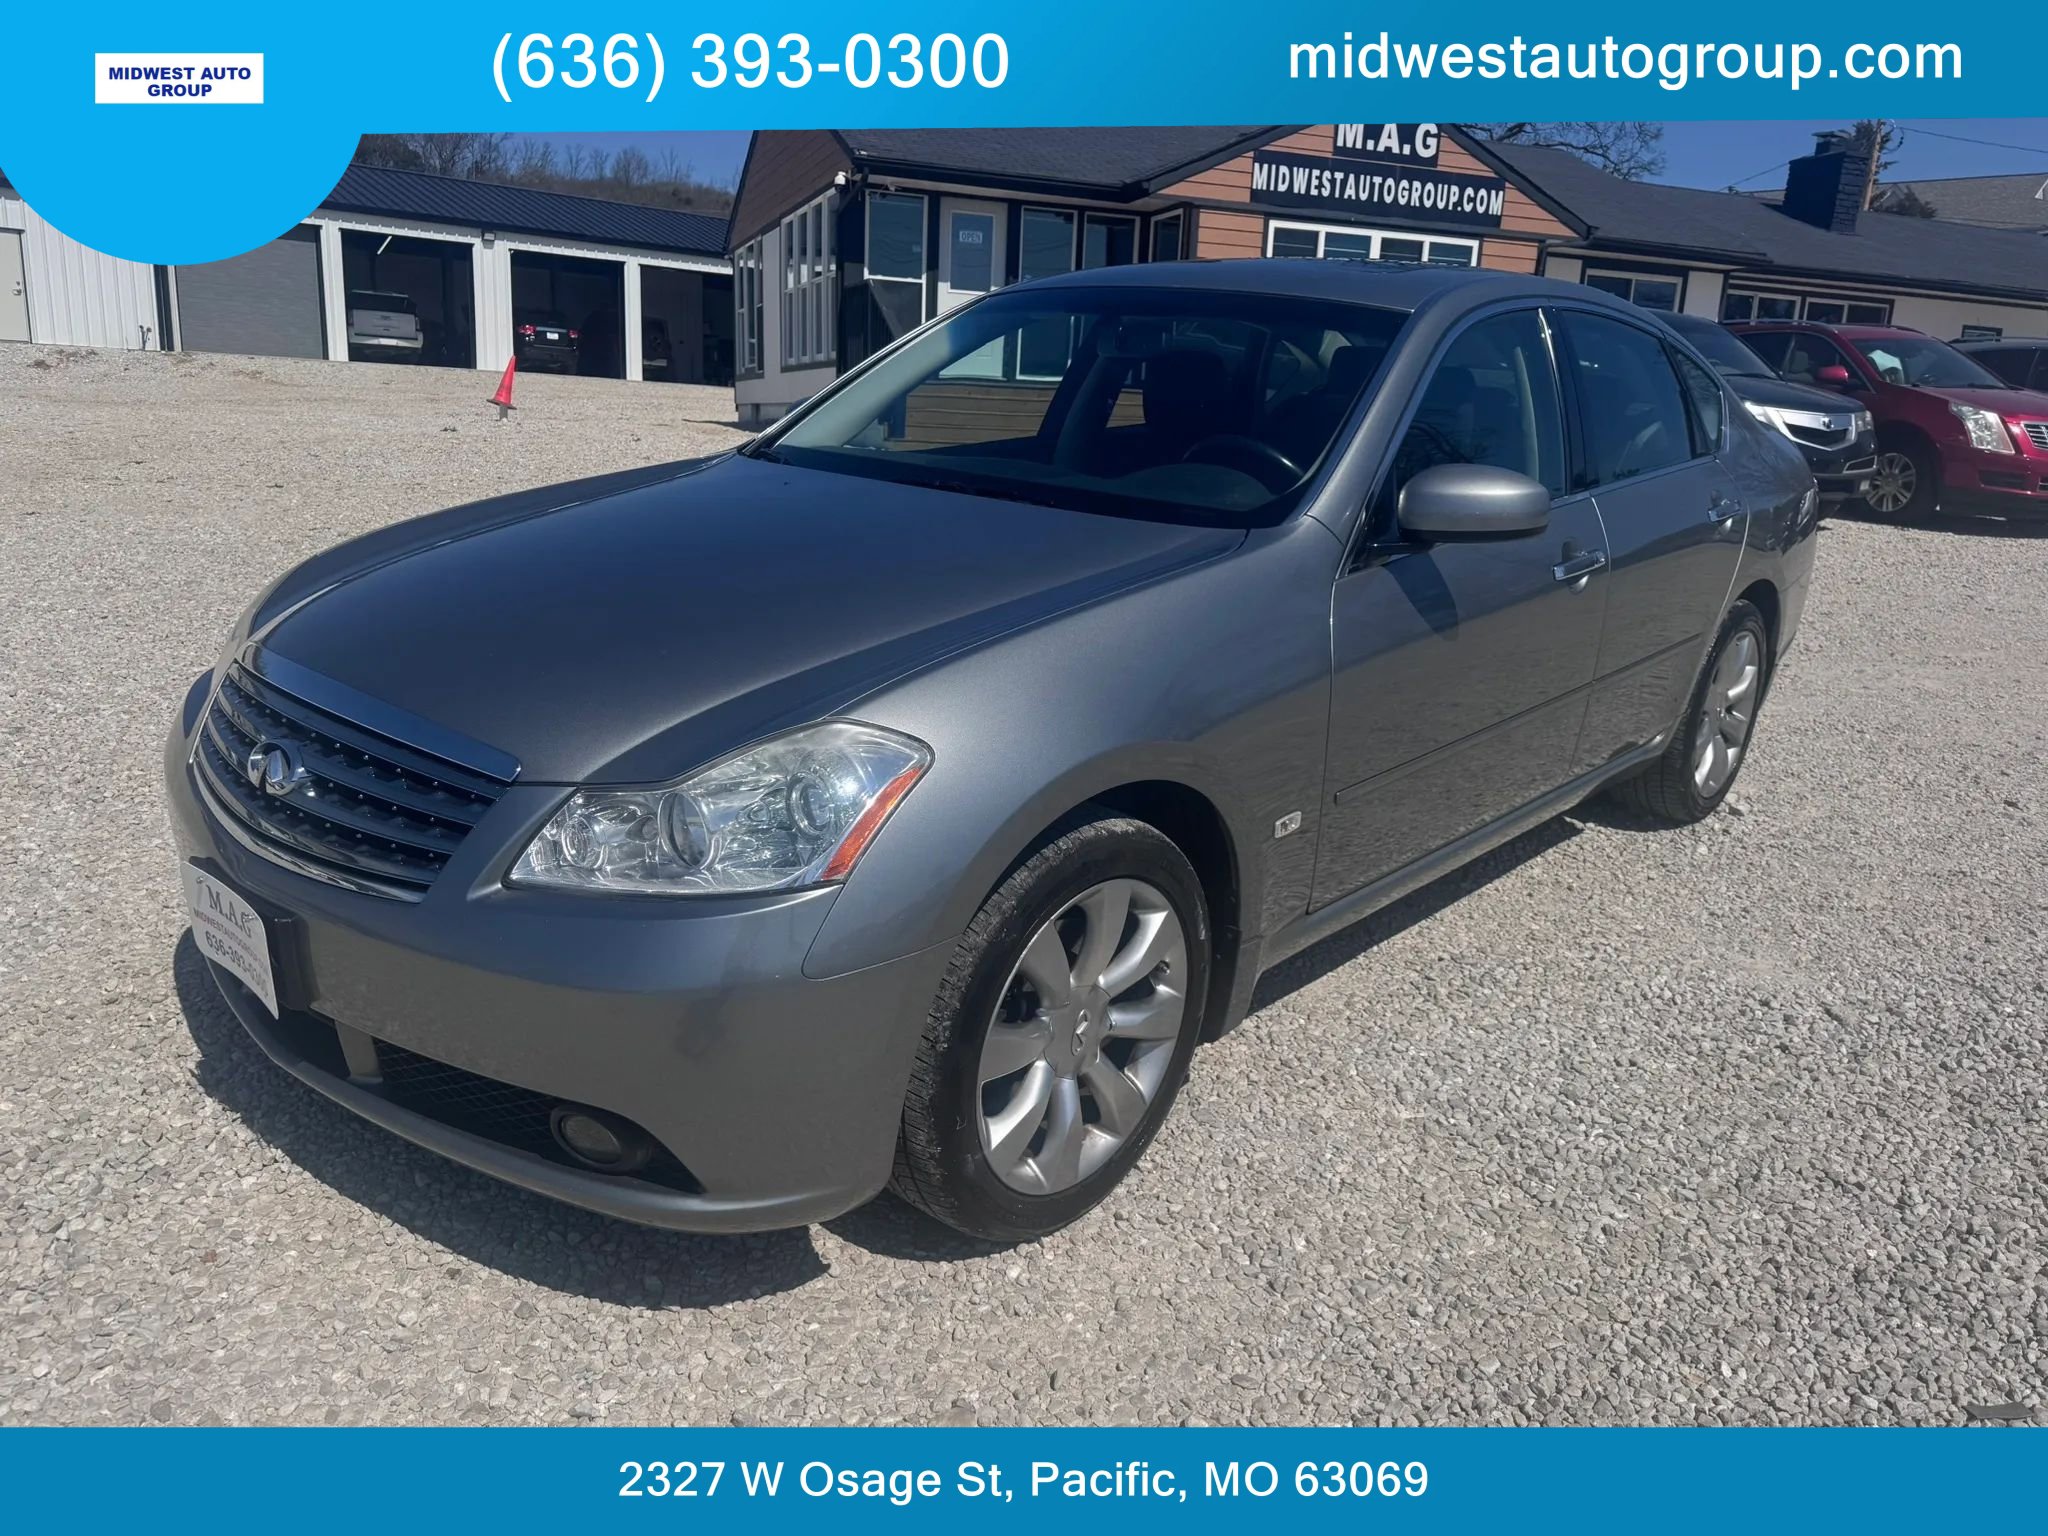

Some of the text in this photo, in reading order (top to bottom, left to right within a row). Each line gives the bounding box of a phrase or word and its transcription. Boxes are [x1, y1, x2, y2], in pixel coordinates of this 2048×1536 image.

[1336, 123, 1439, 158] M.A.G
[1252, 162, 1505, 216] MIDWESTAUTOGROUP.COM
[961, 232, 982, 242] OPEN
